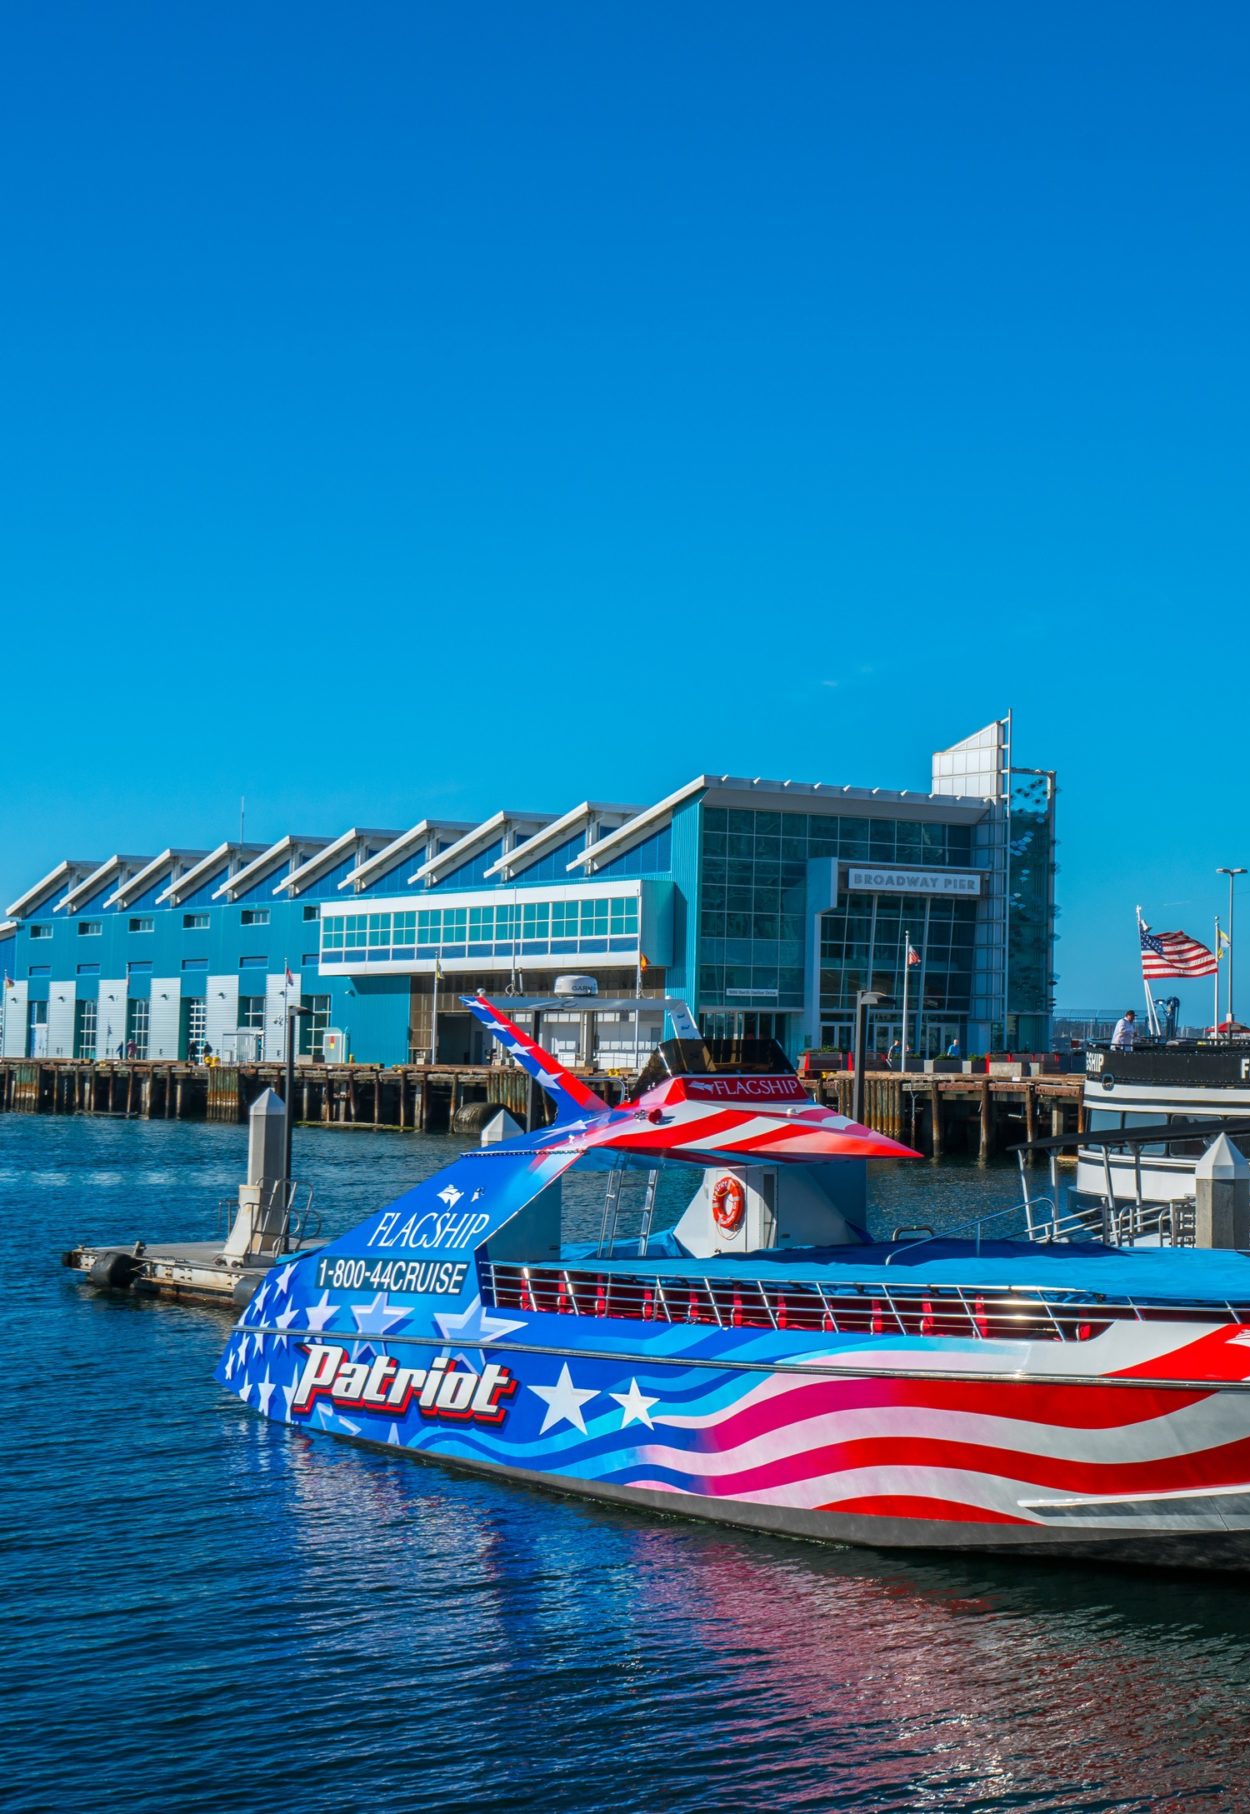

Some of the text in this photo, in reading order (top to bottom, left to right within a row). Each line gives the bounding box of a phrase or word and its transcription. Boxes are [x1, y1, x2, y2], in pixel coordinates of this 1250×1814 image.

[854, 873, 975, 890] BROADWAY PIER
[713, 1080, 798, 1095] FLAGSHIP
[367, 1212, 490, 1249] FLAGSHIP
[319, 1259, 467, 1294] 1-800-44CRUISE
[293, 1344, 513, 1422] Patriot
